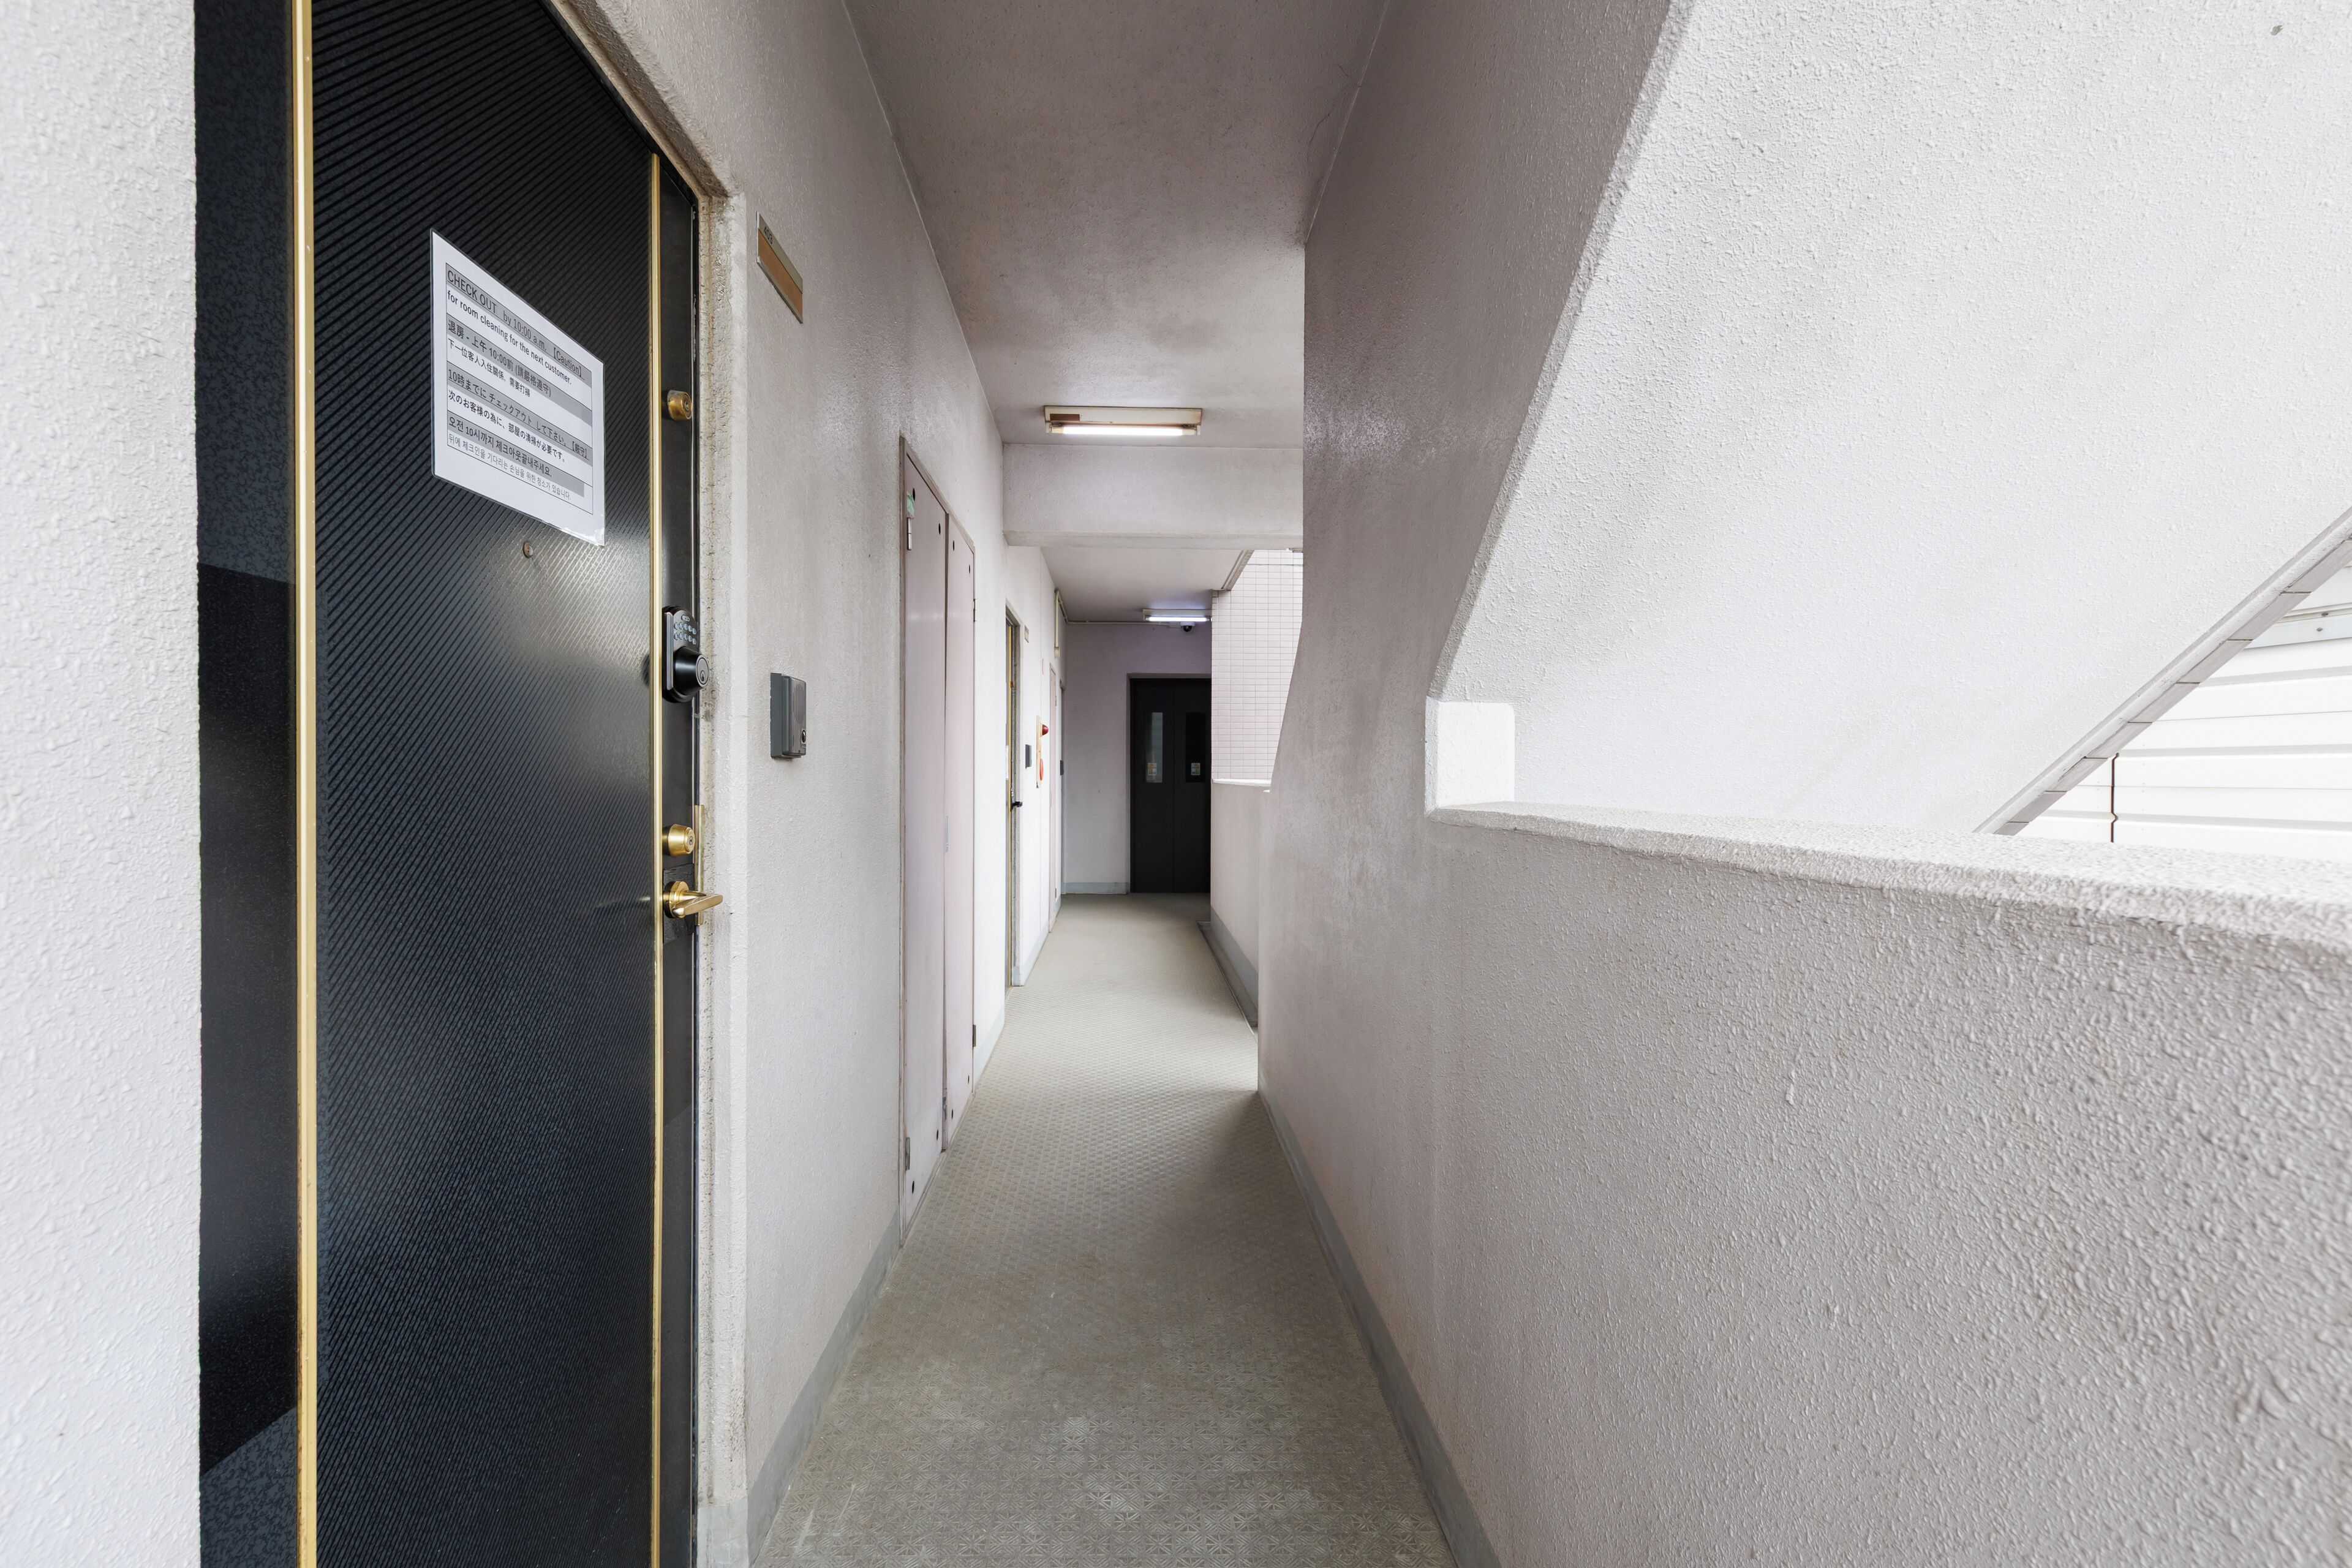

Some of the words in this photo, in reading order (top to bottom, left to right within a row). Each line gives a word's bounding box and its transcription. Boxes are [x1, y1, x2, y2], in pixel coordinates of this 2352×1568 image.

[764, 227, 772, 244] 403
[447, 290, 458, 305] for
[460, 300, 478, 319] room
[480, 315, 508, 342] cleaning
[510, 334, 518, 347] for
[519, 341, 530, 355] the
[531, 350, 544, 366] next
[545, 361, 572, 385] customer.
[448, 270, 477, 301] CHECK
[480, 294, 497, 314] OUT
[503, 311, 511, 326] by
[513, 318, 531, 339] 10:00
[533, 334, 547, 351] a.m.
[553, 347, 582, 377] 【Caution】
[448, 319, 464, 339] 退房
[471, 336, 488, 353] 上午
[489, 347, 514, 372] 10:00前
[448, 369, 487, 398] 10時までに
[489, 393, 532, 425] チェックアウト
[536, 420, 567, 447] して下さい。
[448, 417, 464, 432] 오전
[466, 426, 494, 448] 10시까지
[496, 439, 552, 477] 체크아웃끝내주세요.
[448, 433, 461, 448] 뒤에
[462, 440, 486, 459] 체크인을
[488, 452, 508, 470] 기다리는
[510, 464, 525, 478] 손님을
[526, 472, 536, 484] 위한
[537, 477, 551, 491] 청소가
[551, 484, 571, 500] 있습니다.
